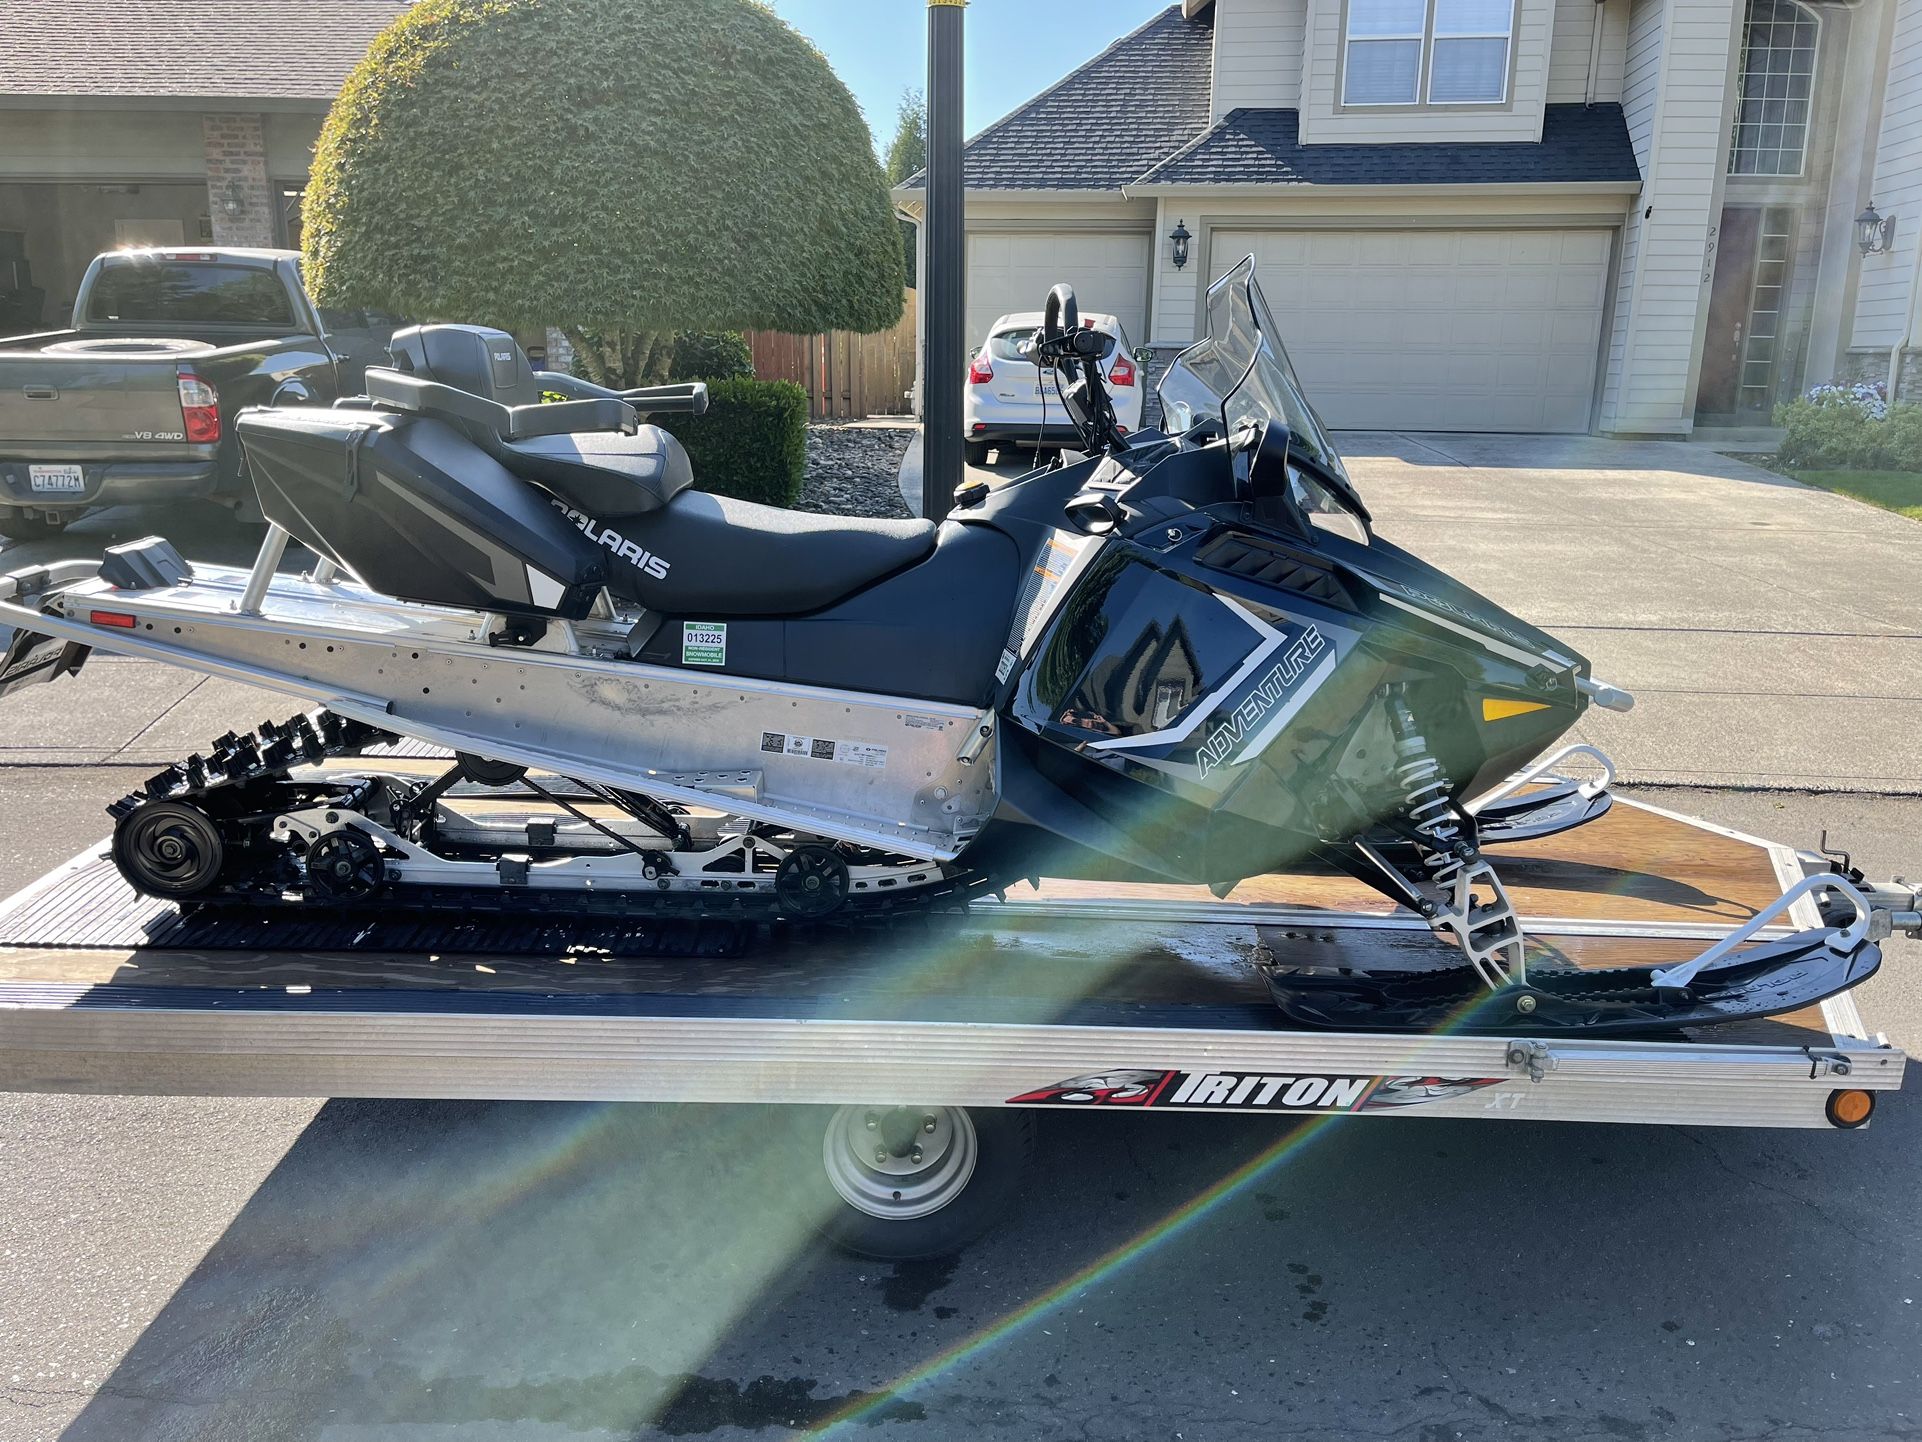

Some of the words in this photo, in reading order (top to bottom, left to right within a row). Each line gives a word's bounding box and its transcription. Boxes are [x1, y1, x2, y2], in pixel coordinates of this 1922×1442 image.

[1703, 226, 1716, 283] 2912
[134, 431, 152, 440] V8
[154, 431, 183, 440] 4WD
[687, 633, 722, 643] 013225
[1196, 624, 1325, 780] ADVENTURE
[1169, 1070, 1370, 1107] TRITON
[1484, 1092, 1526, 1109] XT
